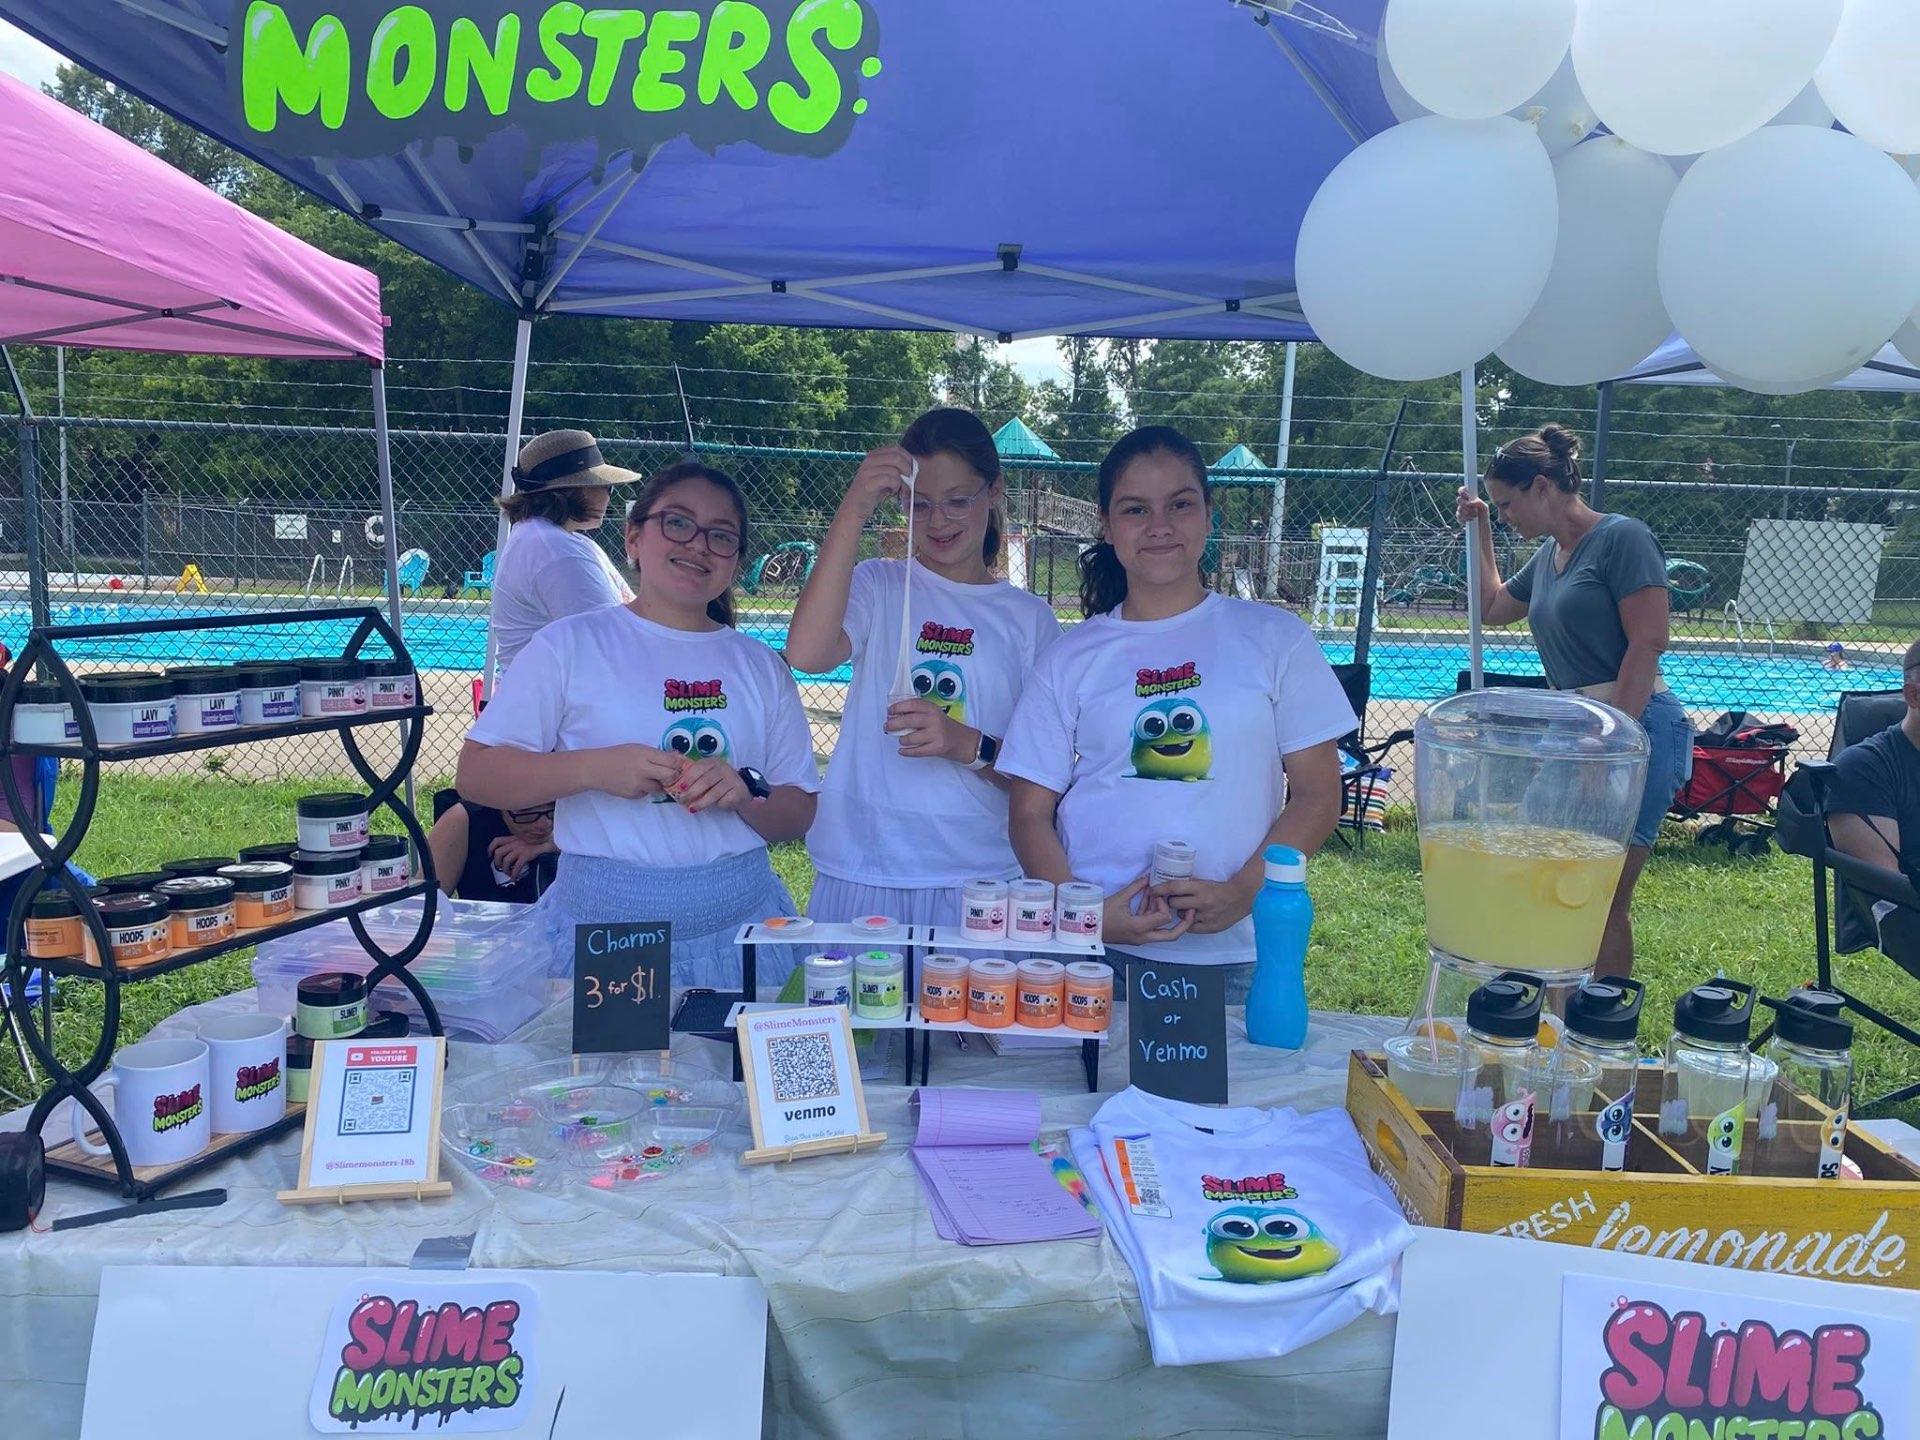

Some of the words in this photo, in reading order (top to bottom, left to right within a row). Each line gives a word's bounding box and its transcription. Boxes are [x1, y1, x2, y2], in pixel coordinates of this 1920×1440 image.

[242, 0, 864, 133] MONSTERS
[916, 637, 974, 656] MONSTERS
[1136, 661, 1196, 686] SLIME
[328, 687, 344, 698] PINKY
[379, 683, 395, 693] PINKY
[664, 679, 722, 697] SLIME
[1135, 674, 1201, 697] MONSTERS
[270, 691, 285, 702] LAVY
[664, 694, 727, 711] MONSTERS
[209, 698, 225, 710] LAVY
[141, 709, 158, 721] LAVY
[336, 821, 352, 832] PINKY
[378, 866, 394, 877] PINKY
[335, 878, 350, 889] PINKY
[270, 888, 288, 901] HOOPS
[970, 908, 984, 918] PINKY
[1022, 910, 1036, 920] PINKY
[1063, 910, 1077, 920] PINKY
[195, 915, 218, 928] HOOPS
[119, 930, 144, 943] HOOPS
[587, 929, 666, 955] Charms
[584, 976, 603, 1008] 3
[608, 981, 628, 994] for
[926, 984, 942, 996] HOOPS
[1139, 971, 1197, 1000] Cash
[971, 989, 985, 1001] HOOPS
[1023, 993, 1040, 1004] HOOPS
[1071, 994, 1088, 1006] HOOPS
[753, 1016, 836, 1032] @SlimeMonsters
[1164, 1014, 1181, 1025] or
[370, 1054, 408, 1062] YOUTUBE
[1139, 1039, 1208, 1063] Venmo
[235, 1071, 281, 1102] MONSTERS
[153, 1097, 203, 1132] MONSTERS
[784, 1105, 836, 1121] venmo
[1201, 1172, 1287, 1193] SLIME
[1203, 1186, 1299, 1201] MONSTERS
[1490, 1190, 1597, 1240] RESH
[341, 1295, 520, 1371] SLIME
[1600, 1300, 1871, 1416] SLIME
[329, 1356, 524, 1416] MONSTERS
